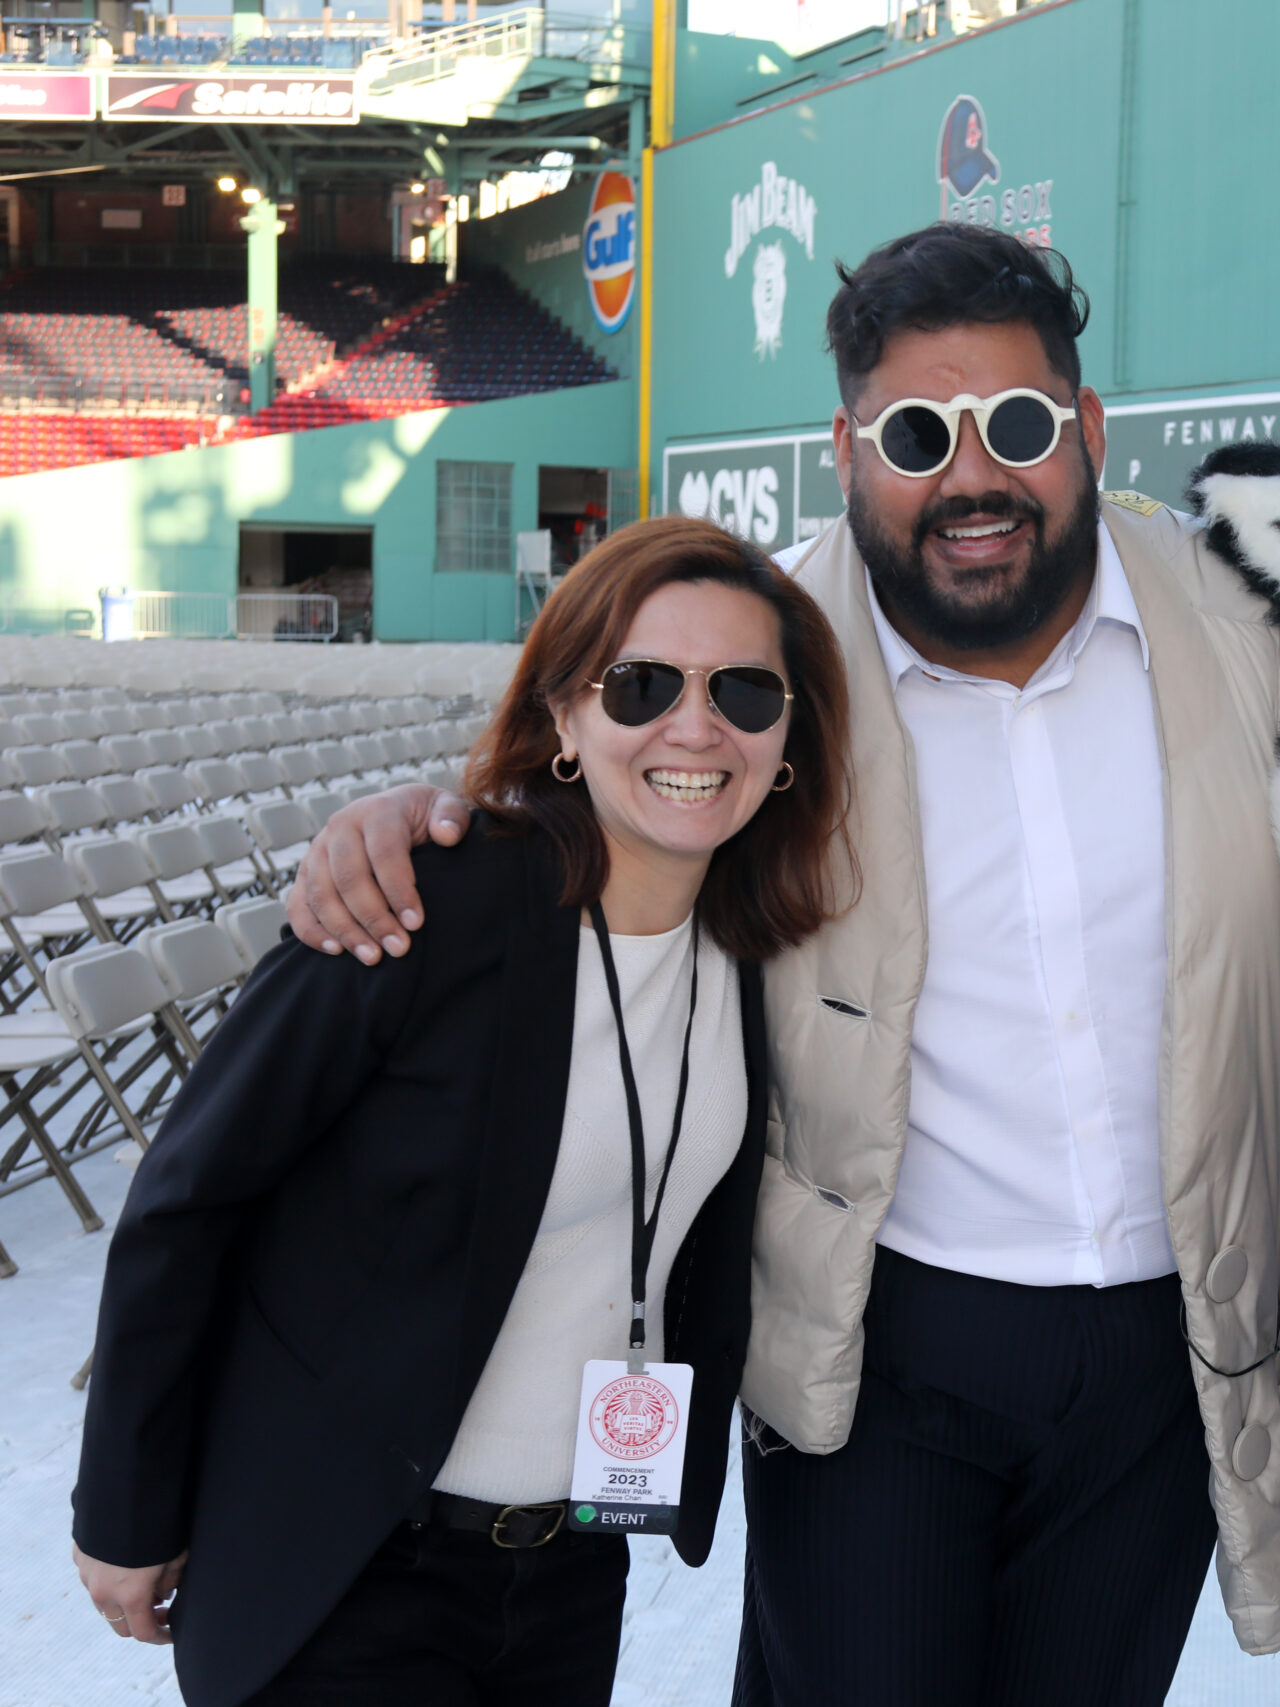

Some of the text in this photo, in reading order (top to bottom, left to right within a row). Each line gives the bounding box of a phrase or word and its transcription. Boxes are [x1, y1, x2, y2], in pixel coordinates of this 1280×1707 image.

[191, 81, 353, 117] Safelite
[1001, 179, 1054, 227] SOX
[724, 160, 817, 279] JIM BEAM
[585, 209, 636, 271] Gulf
[1164, 415, 1278, 446] FENWAY
[1128, 459, 1142, 485] P
[711, 465, 779, 544] CVS
[600, 1380, 672, 1407] NORTHEASTERN
[602, 1437, 661, 1456] UNIVERSITY
[602, 1466, 655, 1474] COMMENCEMENT
[608, 1473, 648, 1488] 2023
[601, 1486, 653, 1496] FENWAY PARK
[601, 1511, 648, 1526] EVENT
